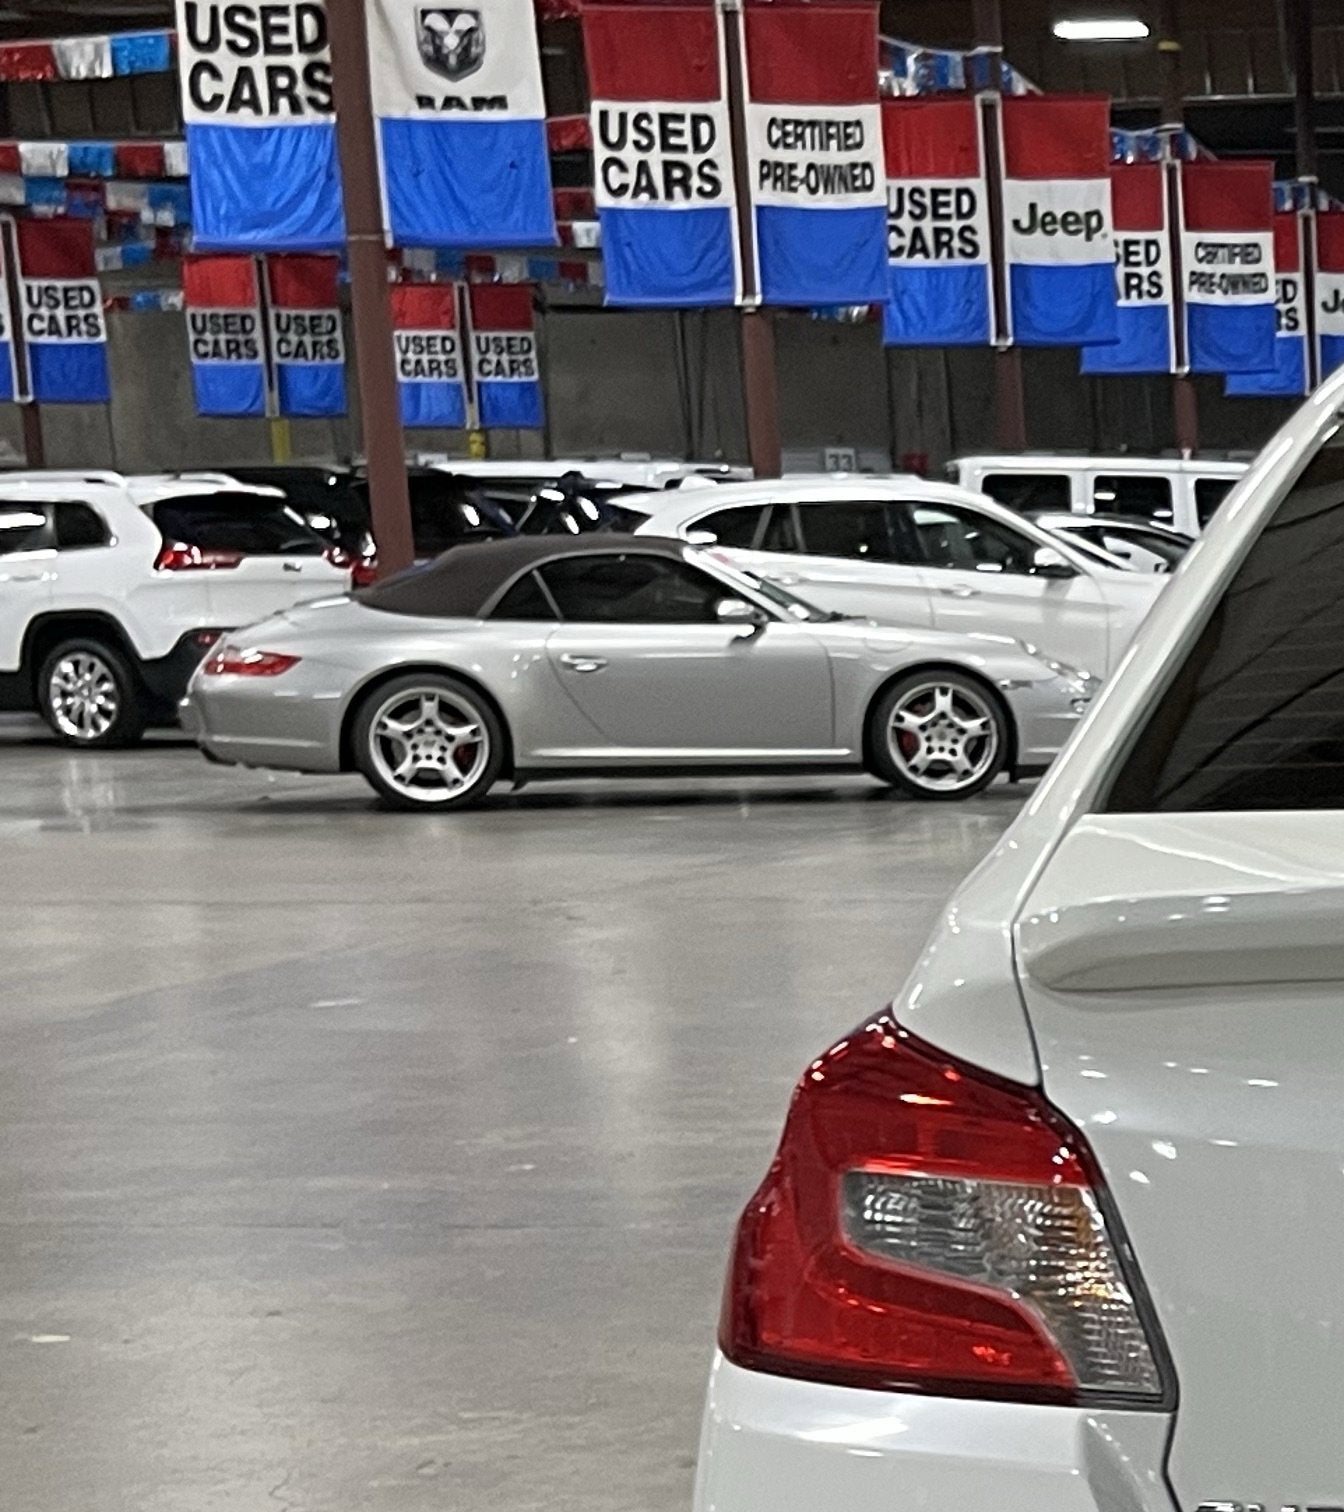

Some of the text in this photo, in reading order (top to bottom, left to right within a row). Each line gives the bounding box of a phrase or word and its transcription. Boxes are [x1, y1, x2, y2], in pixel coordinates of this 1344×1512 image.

[184, 1, 328, 57] USED
[188, 59, 334, 115] CARS
[415, 94, 508, 111] RAM
[599, 109, 716, 154] USED
[766, 117, 865, 151] CERTIFIED
[601, 156, 722, 200] CARS
[759, 159, 875, 195] PRE-OWNED
[887, 186, 977, 221] USED
[1012, 202, 1104, 242] Jeep
[888, 225, 980, 259] CARS
[1194, 242, 1262, 265] CERTIFIED
[1189, 271, 1269, 295] PRE-OWNED
[26, 284, 95, 310] USED
[27, 312, 101, 338] CARS
[191, 313, 255, 335] USED
[275, 313, 337, 335] USED
[193, 338, 258, 360] CARS
[277, 338, 340, 361] CARS
[395, 334, 456, 356] USED
[475, 335, 532, 356] USED
[400, 359, 457, 379] CARS
[478, 359, 534, 377] CARS
